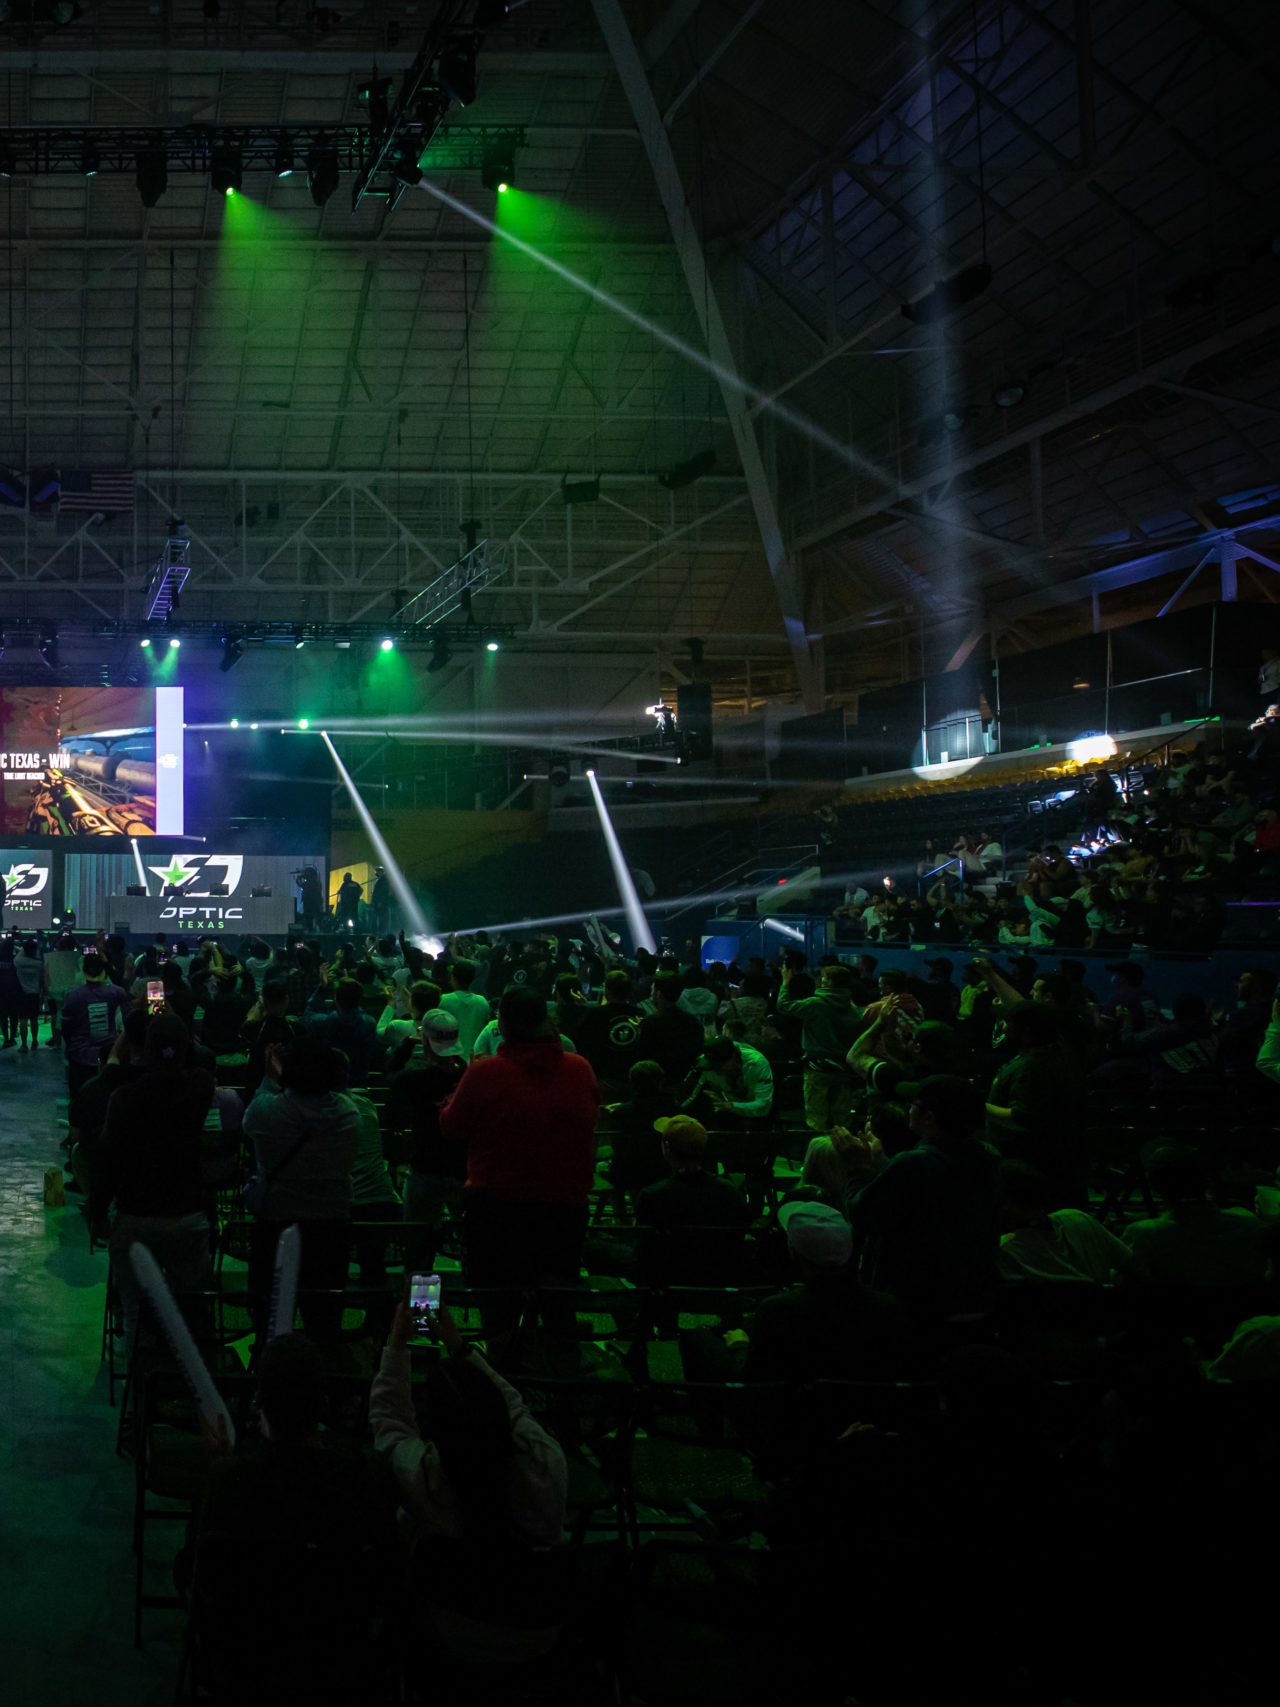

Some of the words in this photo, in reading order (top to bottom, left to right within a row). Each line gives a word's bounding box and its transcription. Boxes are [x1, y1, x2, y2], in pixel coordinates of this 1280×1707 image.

[10, 753, 40, 769] TEXAS
[49, 753, 70, 769] WIN
[4, 899, 42, 907] OPTIC
[159, 907, 243, 919] OPTIC
[178, 920, 224, 929] TEXAS
